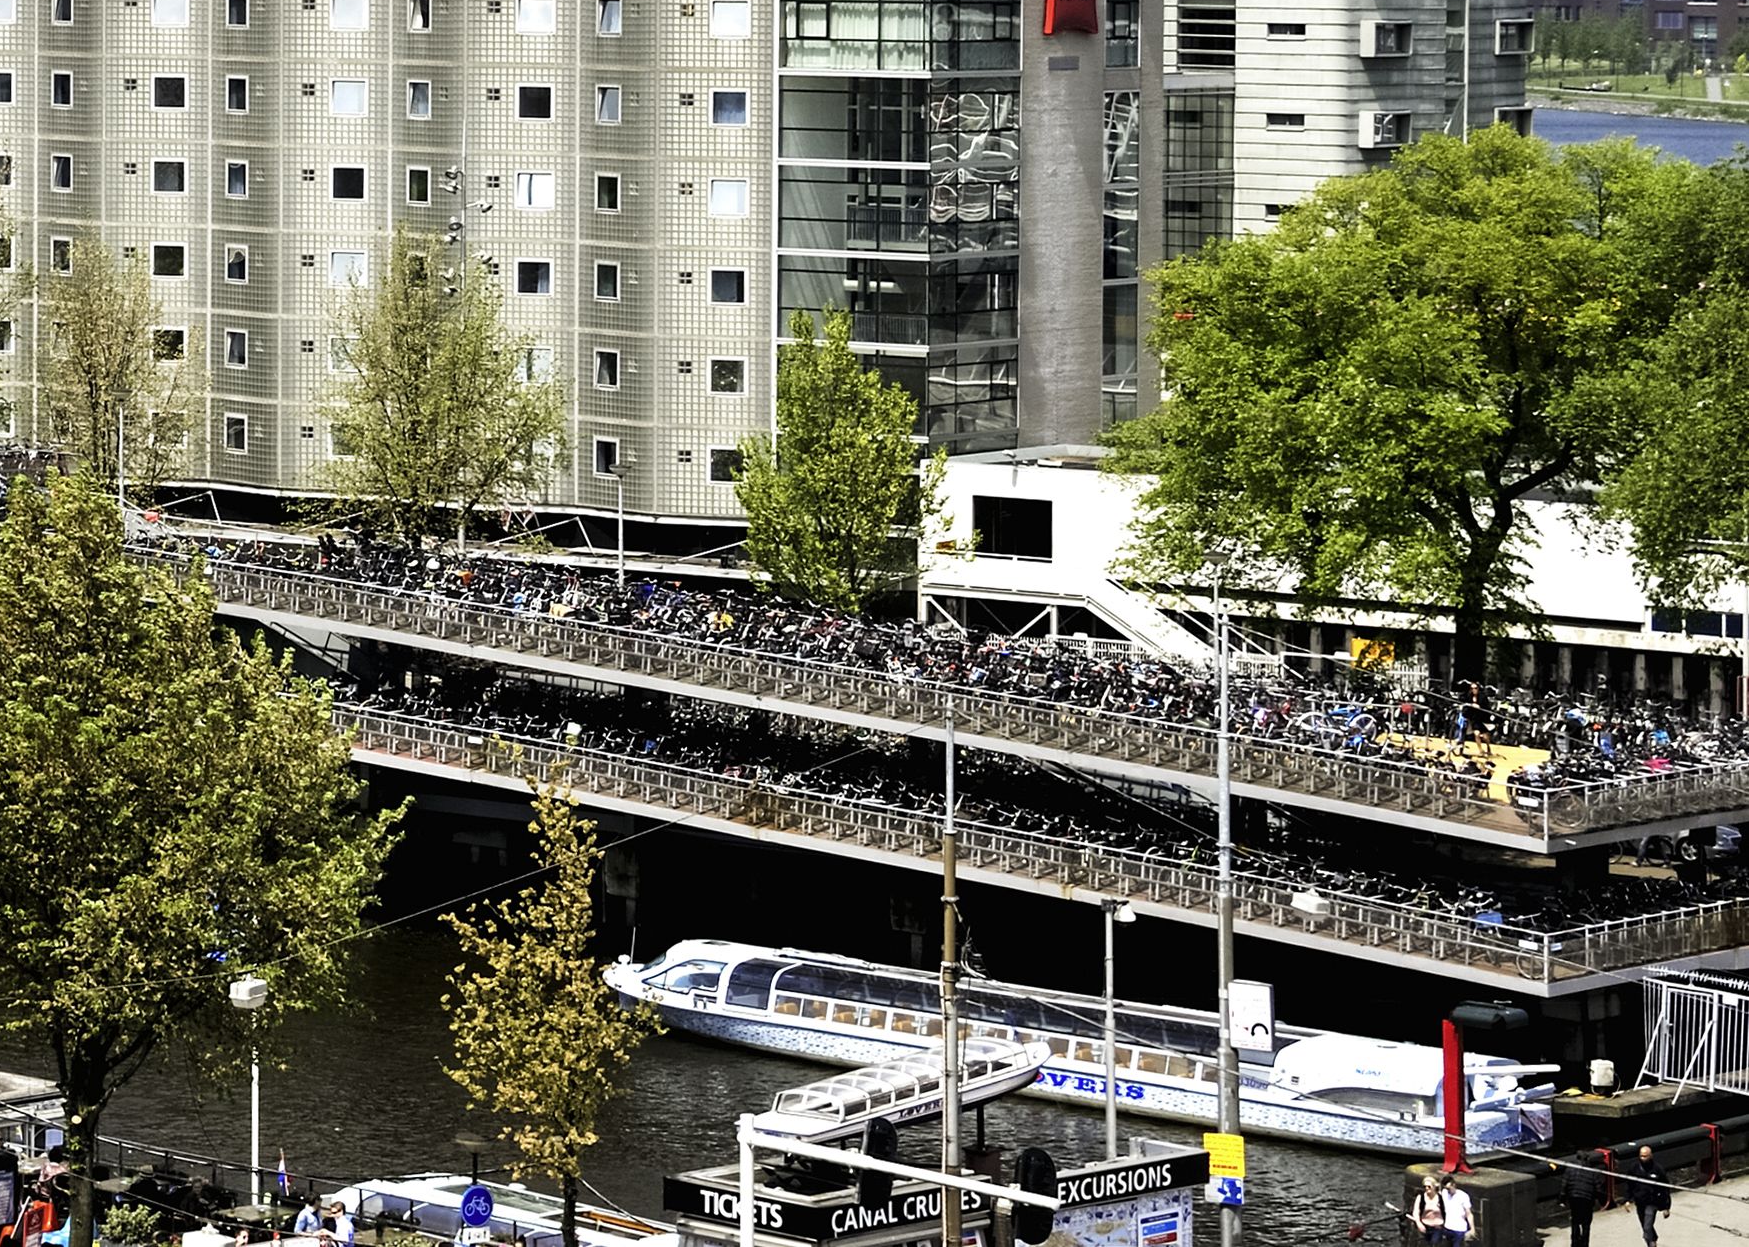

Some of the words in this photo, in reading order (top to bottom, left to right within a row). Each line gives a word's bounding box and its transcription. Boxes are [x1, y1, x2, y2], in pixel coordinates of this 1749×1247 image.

[1035, 1072, 1145, 1100] OVERS
[1057, 1163, 1172, 1205] EXCURSIONS
[831, 1201, 898, 1234] CANAL
[903, 1190, 982, 1220] CRUES
